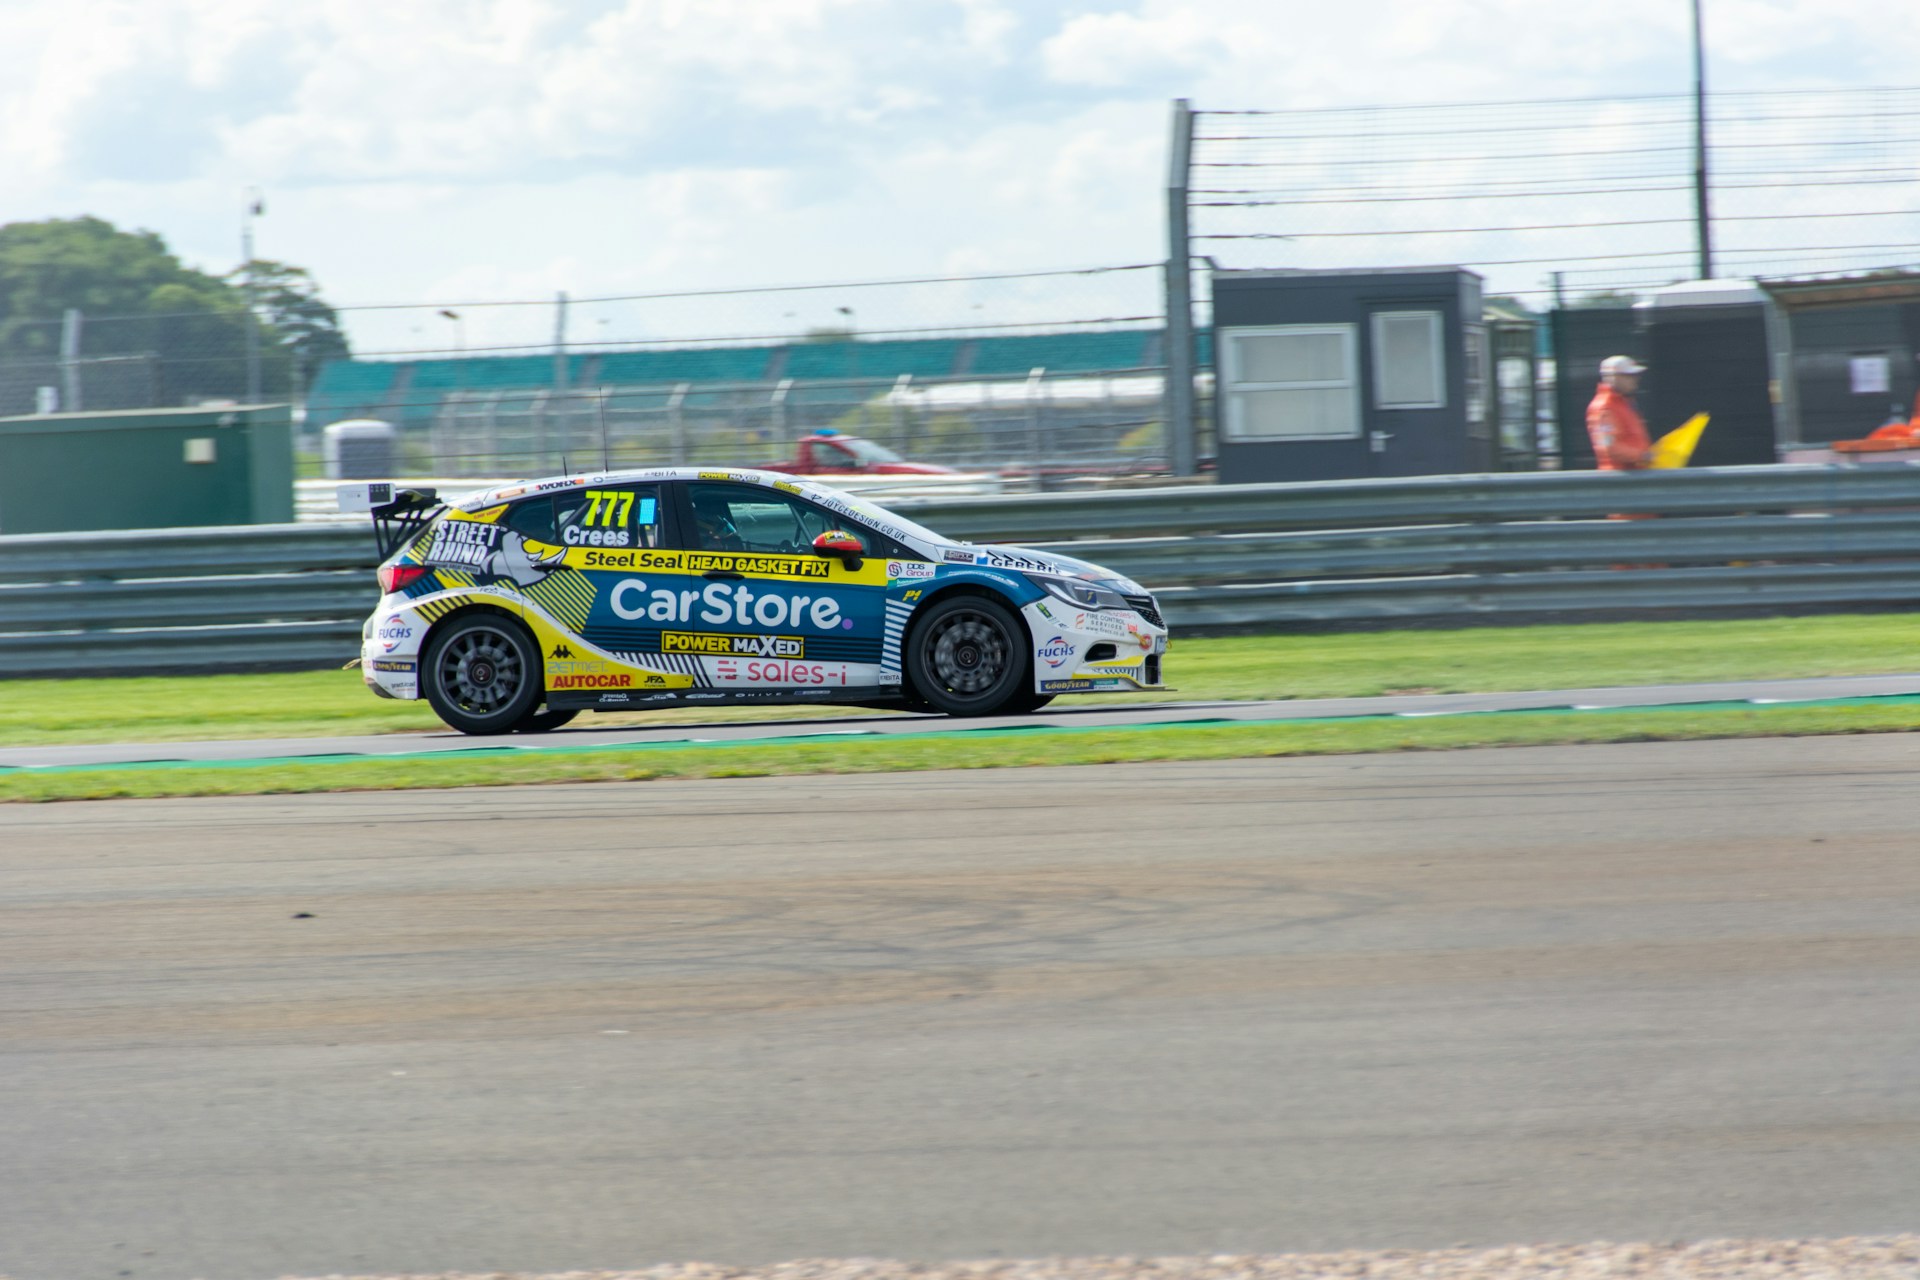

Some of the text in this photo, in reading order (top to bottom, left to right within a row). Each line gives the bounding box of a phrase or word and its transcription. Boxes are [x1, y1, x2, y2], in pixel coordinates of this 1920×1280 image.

[700, 472, 728, 480] POWER
[585, 491, 635, 527] 777
[822, 499, 906, 542] JOYCEDESIGN.CO.UK
[435, 520, 500, 546] STREET
[563, 525, 629, 545] Crees
[428, 541, 488, 565] RHINO
[585, 551, 683, 568] Steel Seal
[690, 556, 828, 576] HEAD GASKET FIX
[1091, 620, 1122, 630] SERVICES
[1100, 615, 1125, 625] CONTROL
[379, 628, 412, 638] FUCHS
[665, 635, 799, 656] POWER MAXED
[1037, 645, 1075, 658] FUCHS
[553, 674, 631, 688] AUTOCAR
[644, 675, 666, 683] JFA
[748, 661, 846, 685] sales-i
[1045, 681, 1089, 690] GOODYEAR
